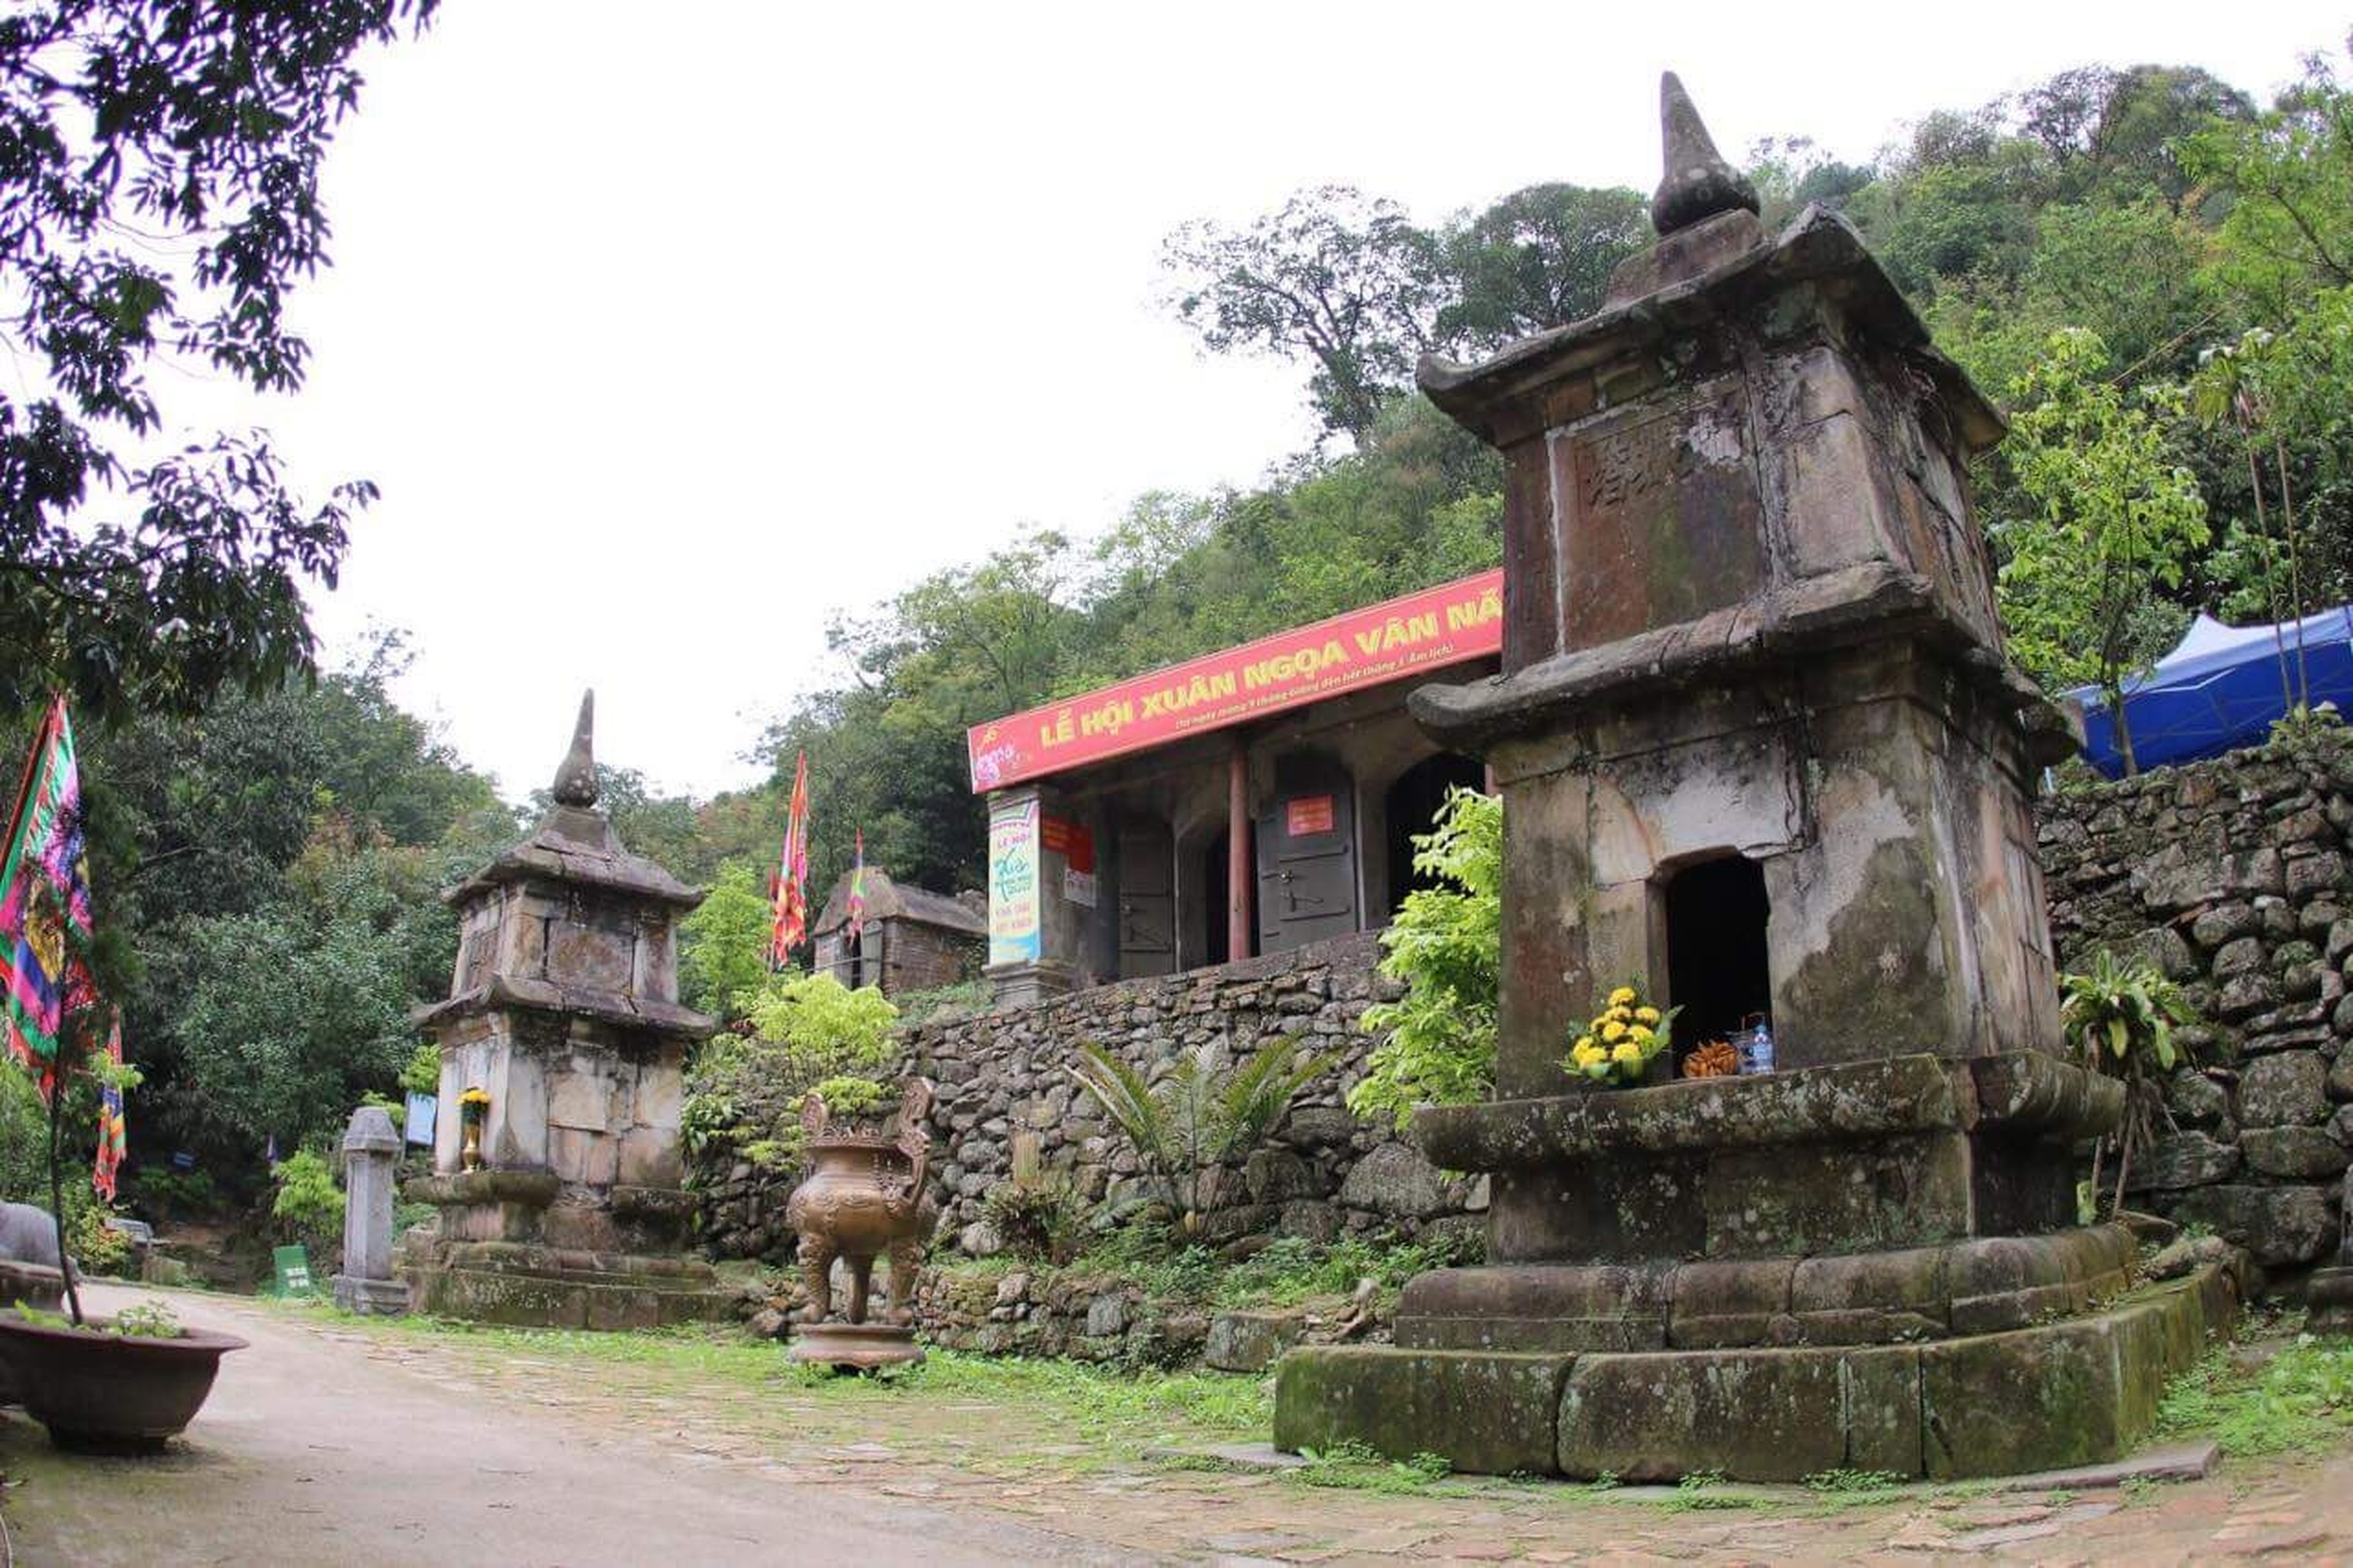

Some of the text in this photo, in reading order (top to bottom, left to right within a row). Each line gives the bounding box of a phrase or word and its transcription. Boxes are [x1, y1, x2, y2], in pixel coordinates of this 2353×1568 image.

[1041, 588, 1502, 748] LỄ HỘI XUÂN NGỌA VÂN NĂ
